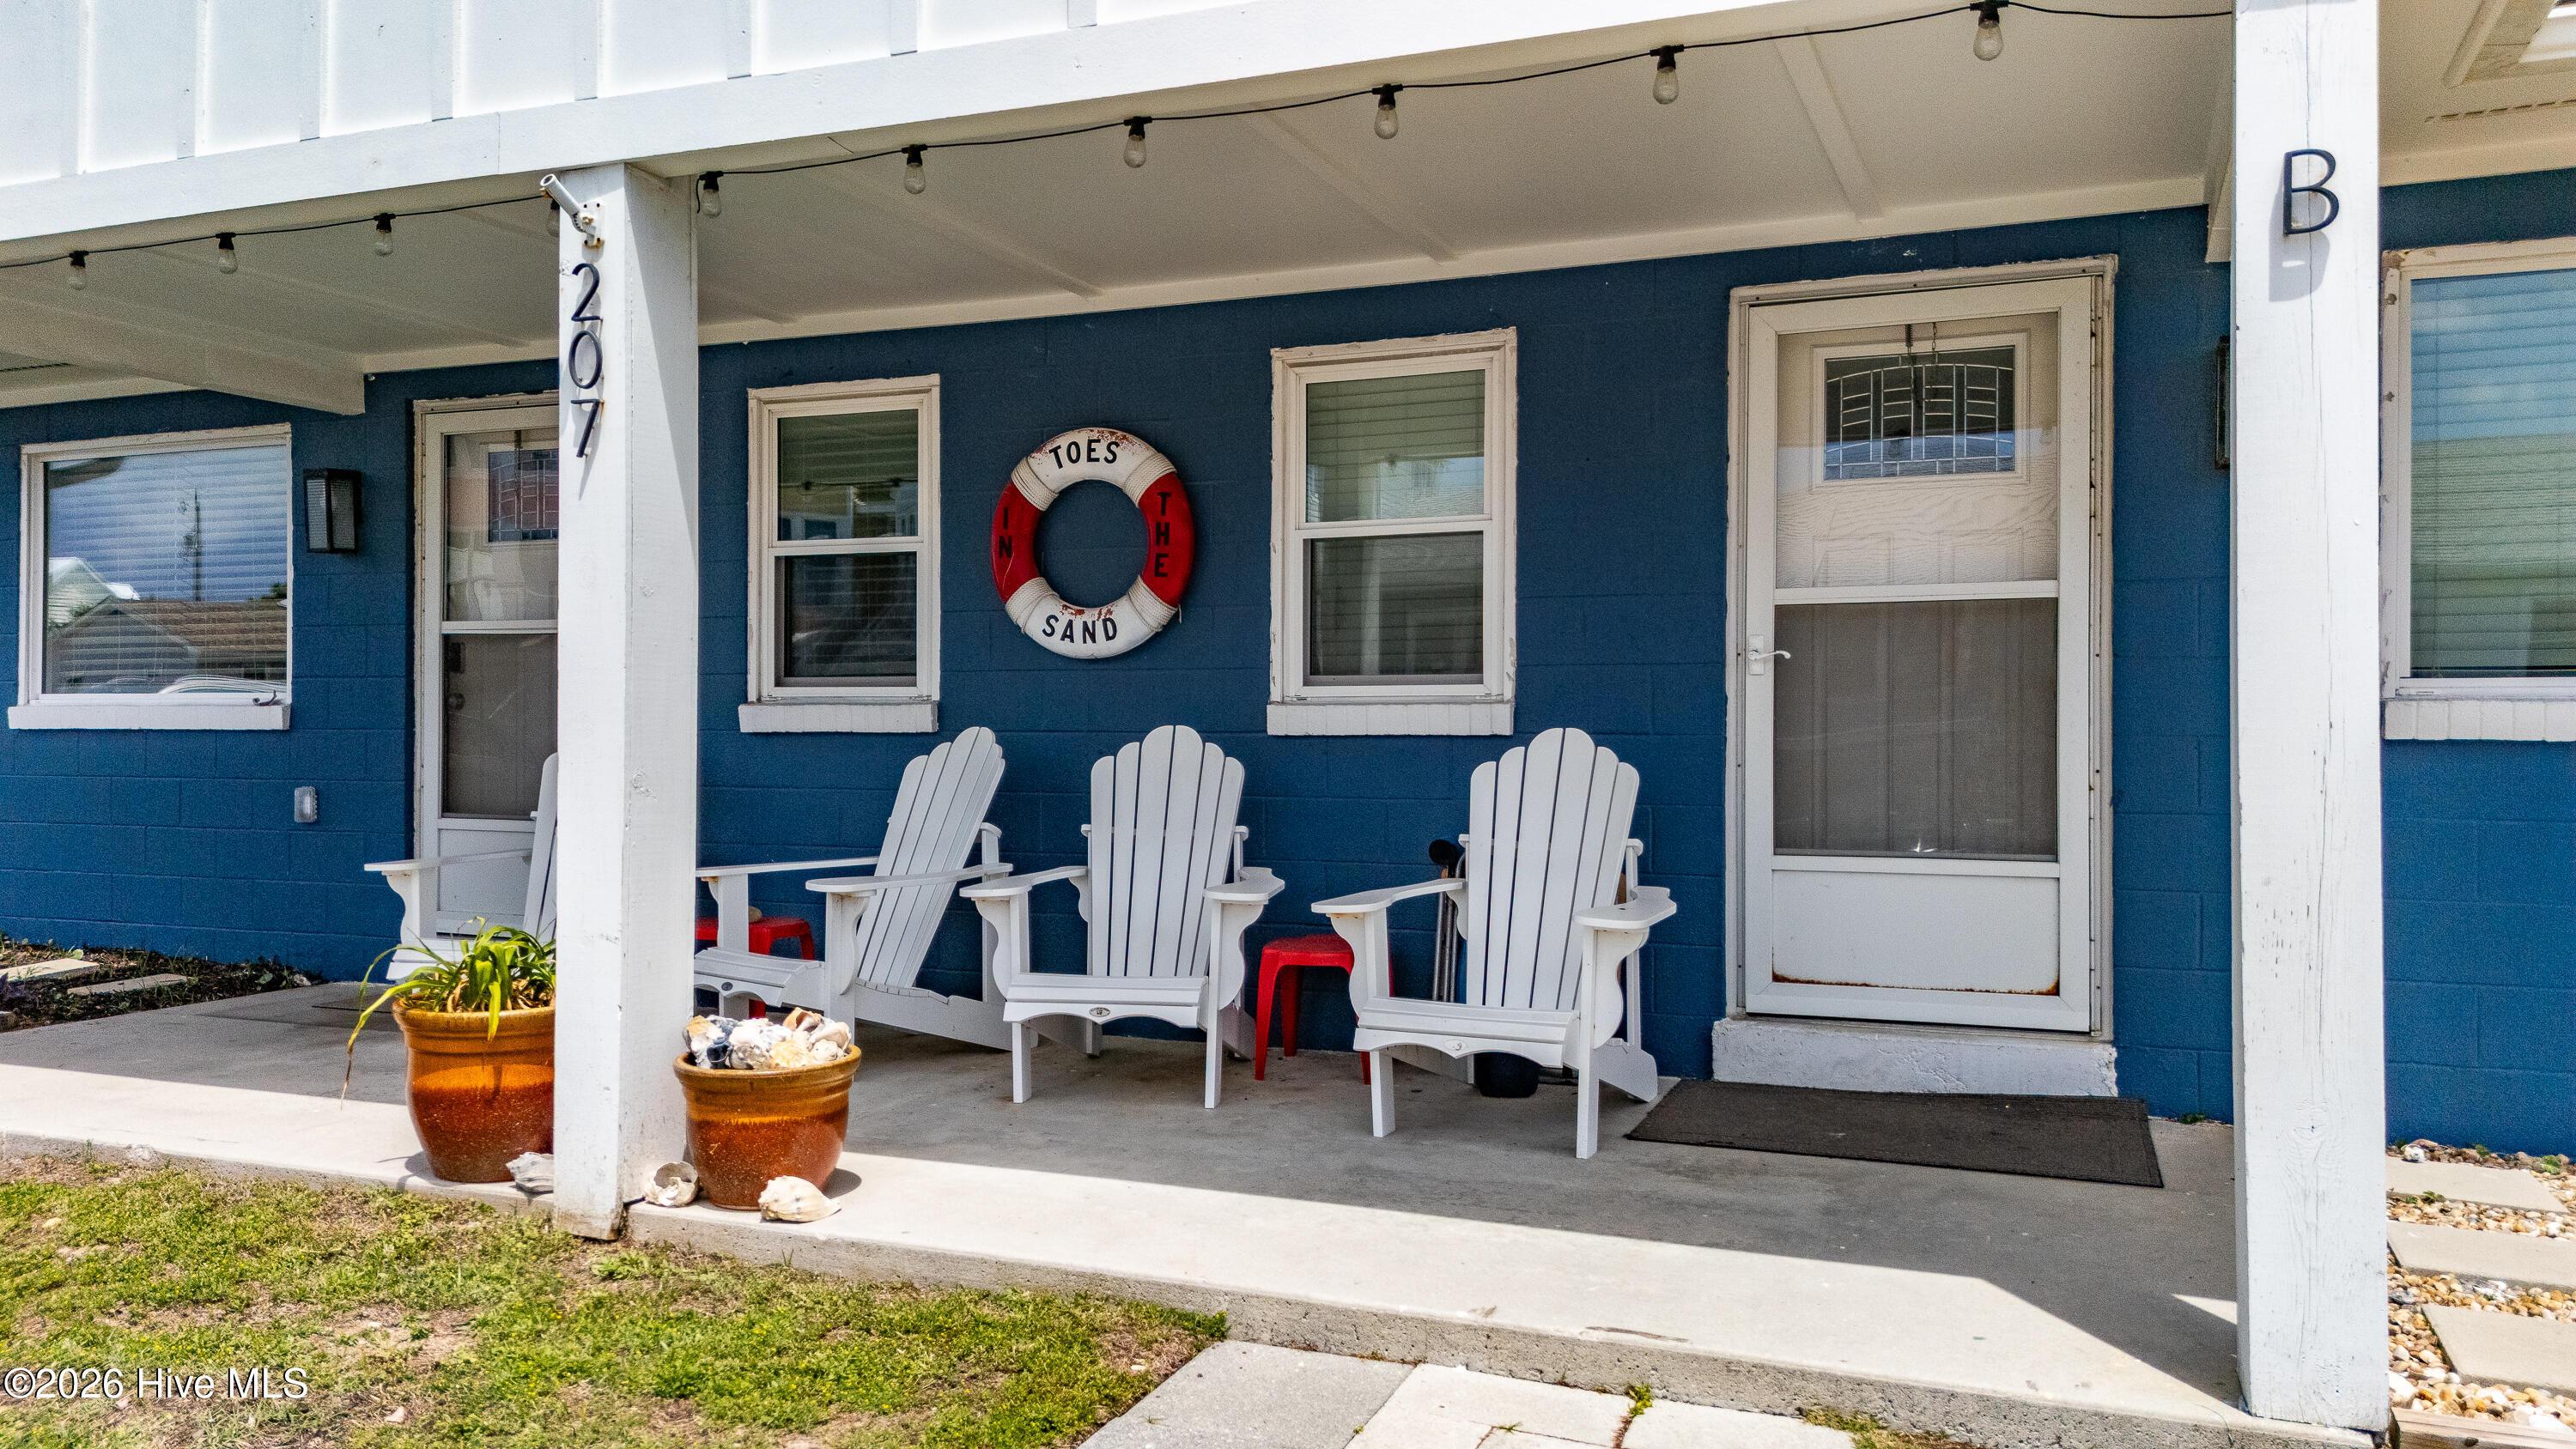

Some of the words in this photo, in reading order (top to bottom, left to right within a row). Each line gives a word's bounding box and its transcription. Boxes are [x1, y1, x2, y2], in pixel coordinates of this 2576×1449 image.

[2282, 149, 2340, 236] B
[568, 263, 603, 458] 207
[1048, 439, 1121, 470] TOES
[999, 507, 1013, 559] IN
[1154, 492, 1171, 578] THE
[1042, 615, 1117, 644] SAND
